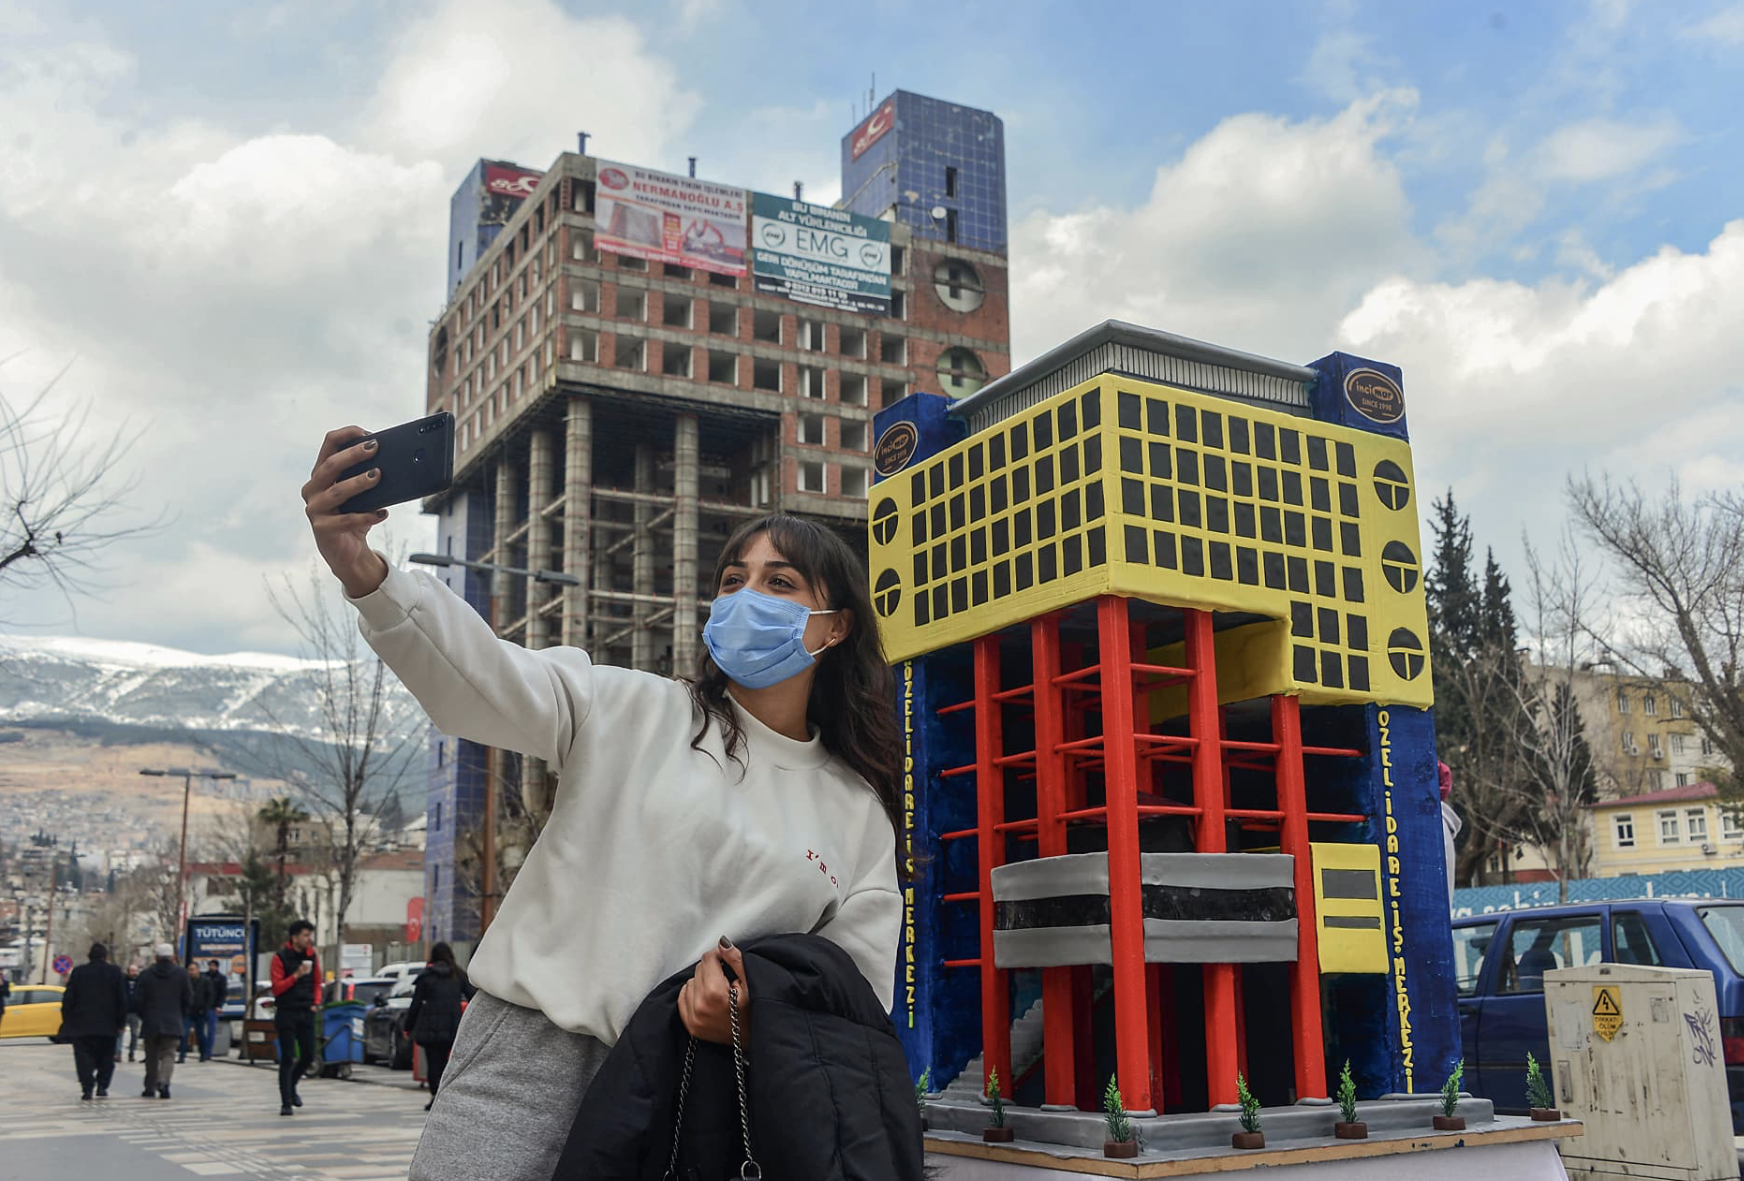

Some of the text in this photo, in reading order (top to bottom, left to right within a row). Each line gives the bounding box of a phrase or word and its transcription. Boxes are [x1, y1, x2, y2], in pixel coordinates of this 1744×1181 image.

[633, 182, 719, 207] NERMANOĞLU
[778, 210, 796, 223] ALT
[792, 201, 808, 213] BU
[797, 228, 849, 260] EMG
[780, 255, 829, 275] DÖNÜŞÜM
